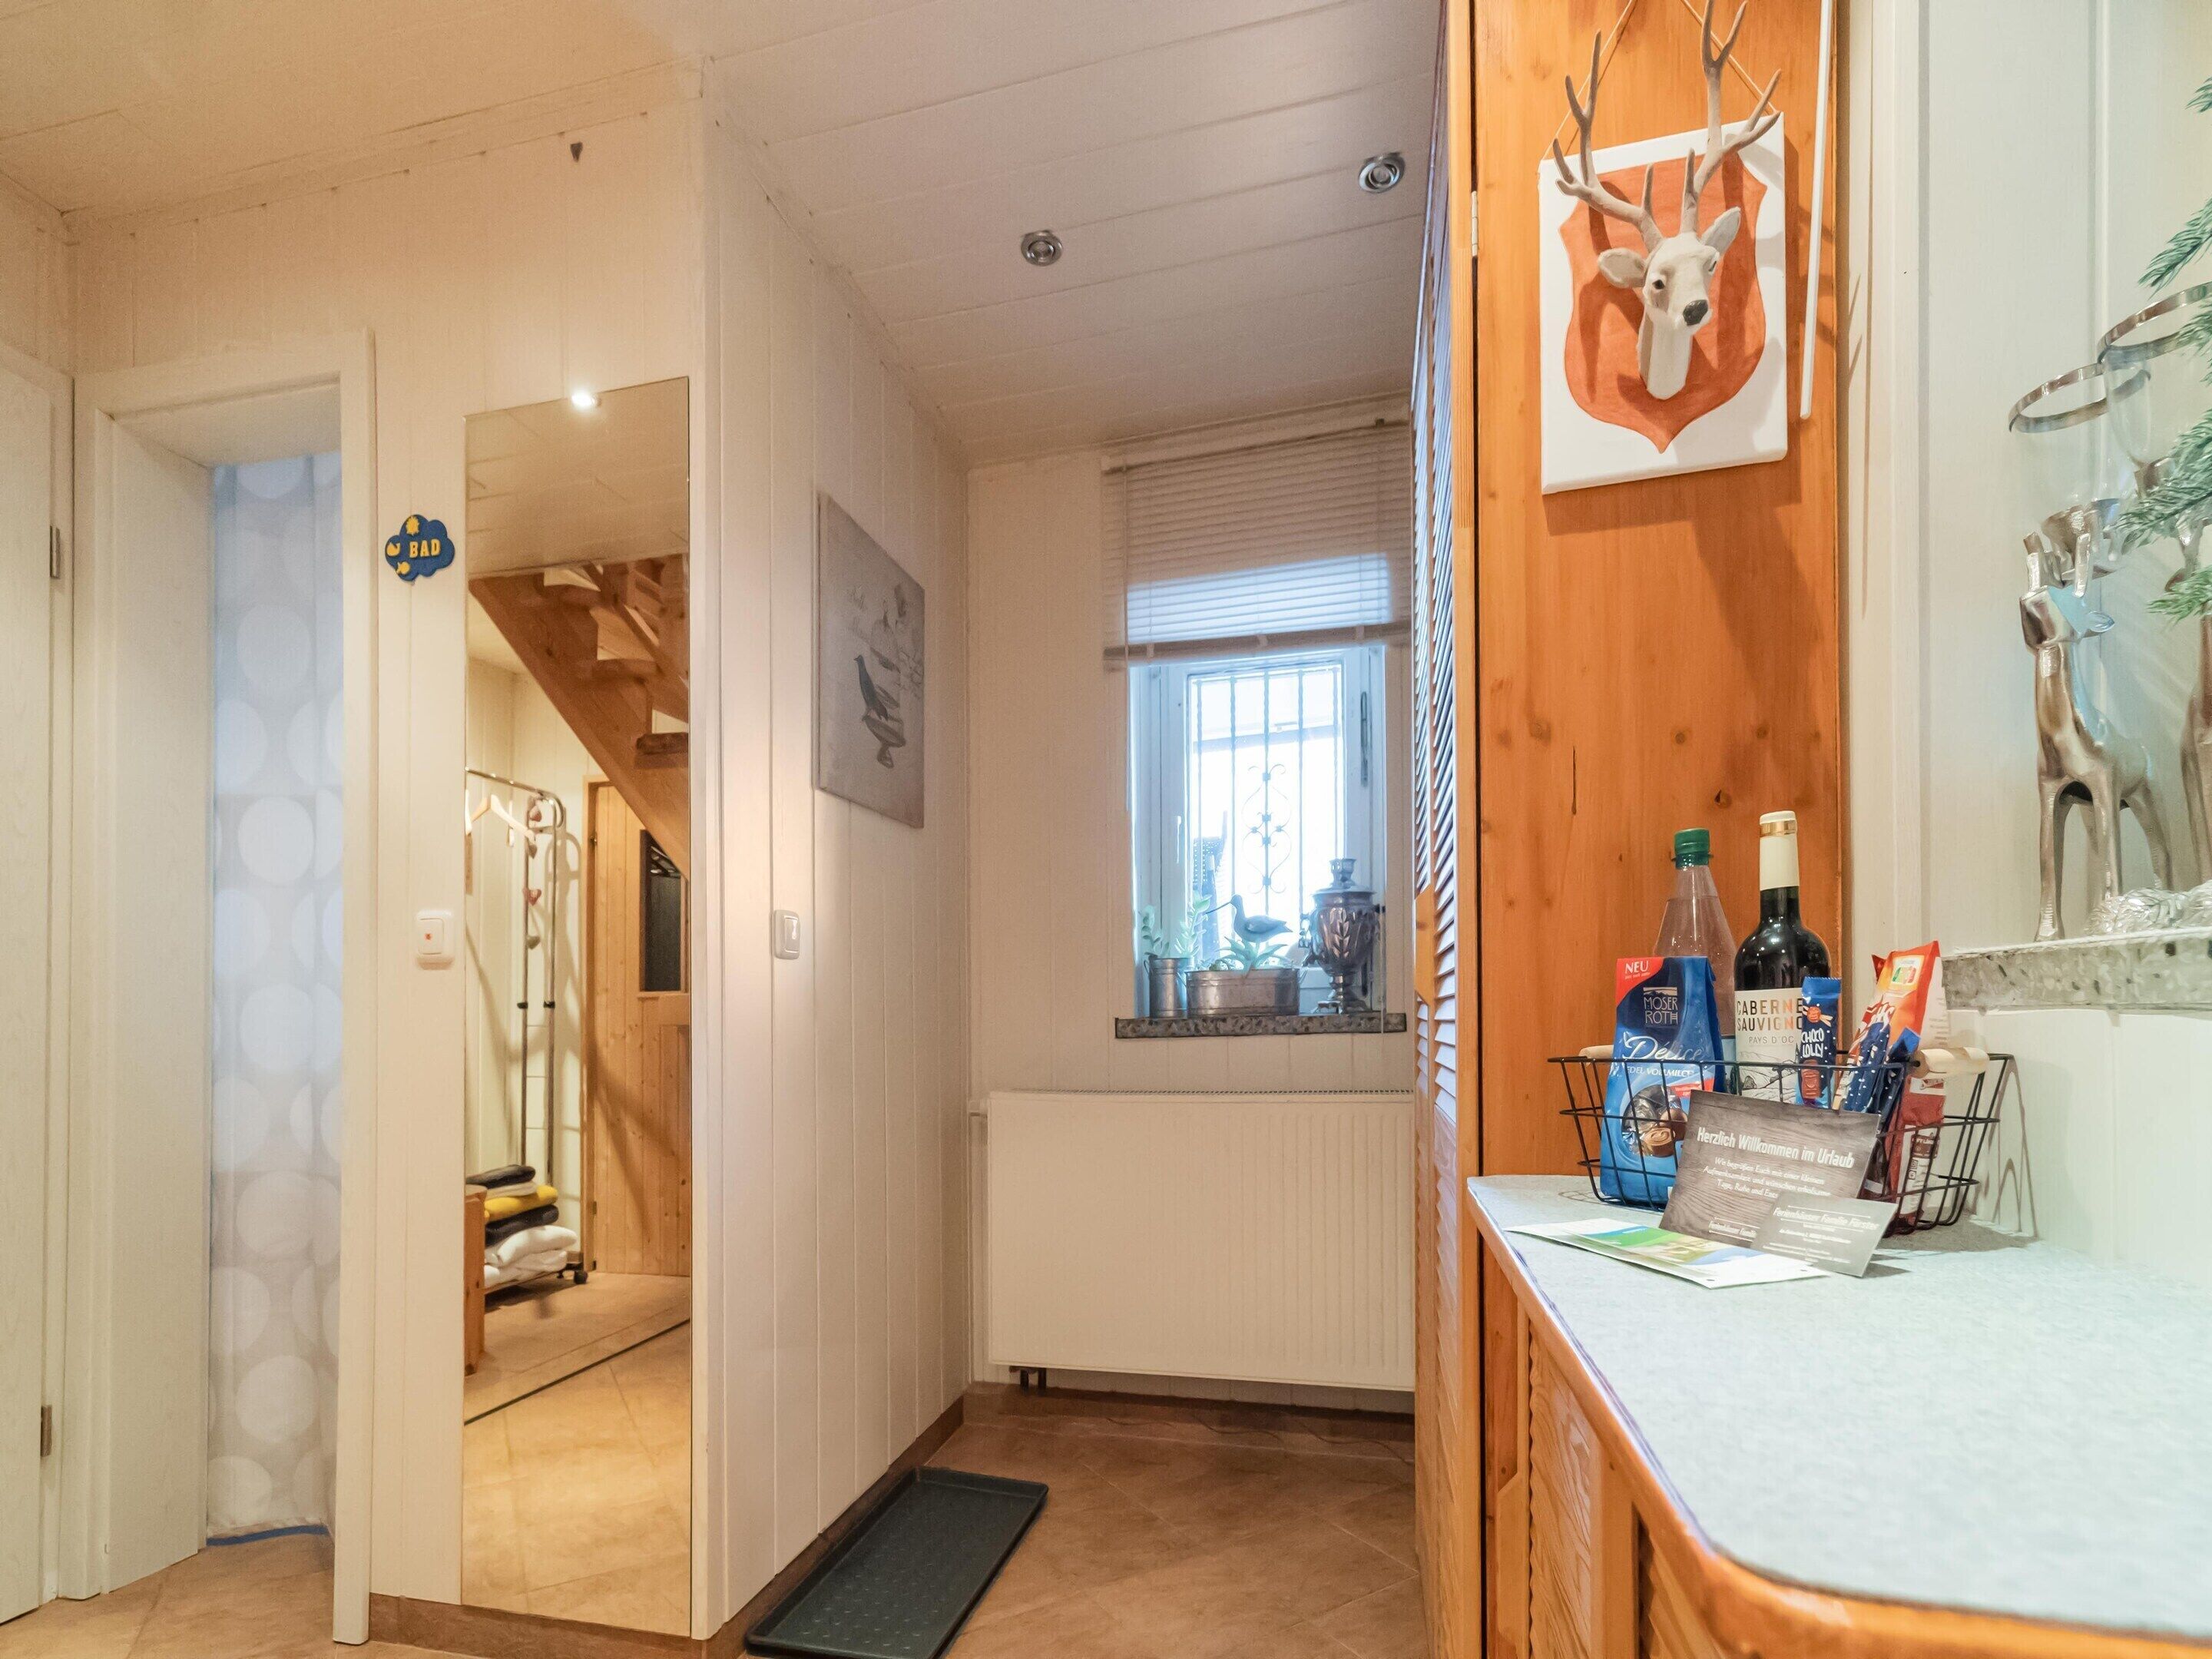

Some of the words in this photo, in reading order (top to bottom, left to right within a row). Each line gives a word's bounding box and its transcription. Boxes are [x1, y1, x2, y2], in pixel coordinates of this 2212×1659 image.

[409, 538, 441, 558] BAD
[1624, 960, 1650, 974] NEU
[1644, 996, 1678, 1011] MOSER
[1737, 998, 1803, 1015] CABERNE
[1644, 1010, 1678, 1025] ROTH
[1737, 1015, 1803, 1031] SAUVIGNO
[1749, 1035, 1767, 1045] PAYS
[1801, 1028, 1825, 1043] CHOCO
[1802, 1043, 1824, 1058] LOLLY
[1697, 1126, 1736, 1148] Herzlich
[1738, 1134, 1799, 1161] Willkommen
[1801, 1145, 1814, 1162] im
[1817, 1147, 1856, 1169] Urlaub
[1755, 1165, 1770, 1174] Euch
[1751, 1187, 1764, 1196] und
[1821, 1214, 1849, 1227] Familie
